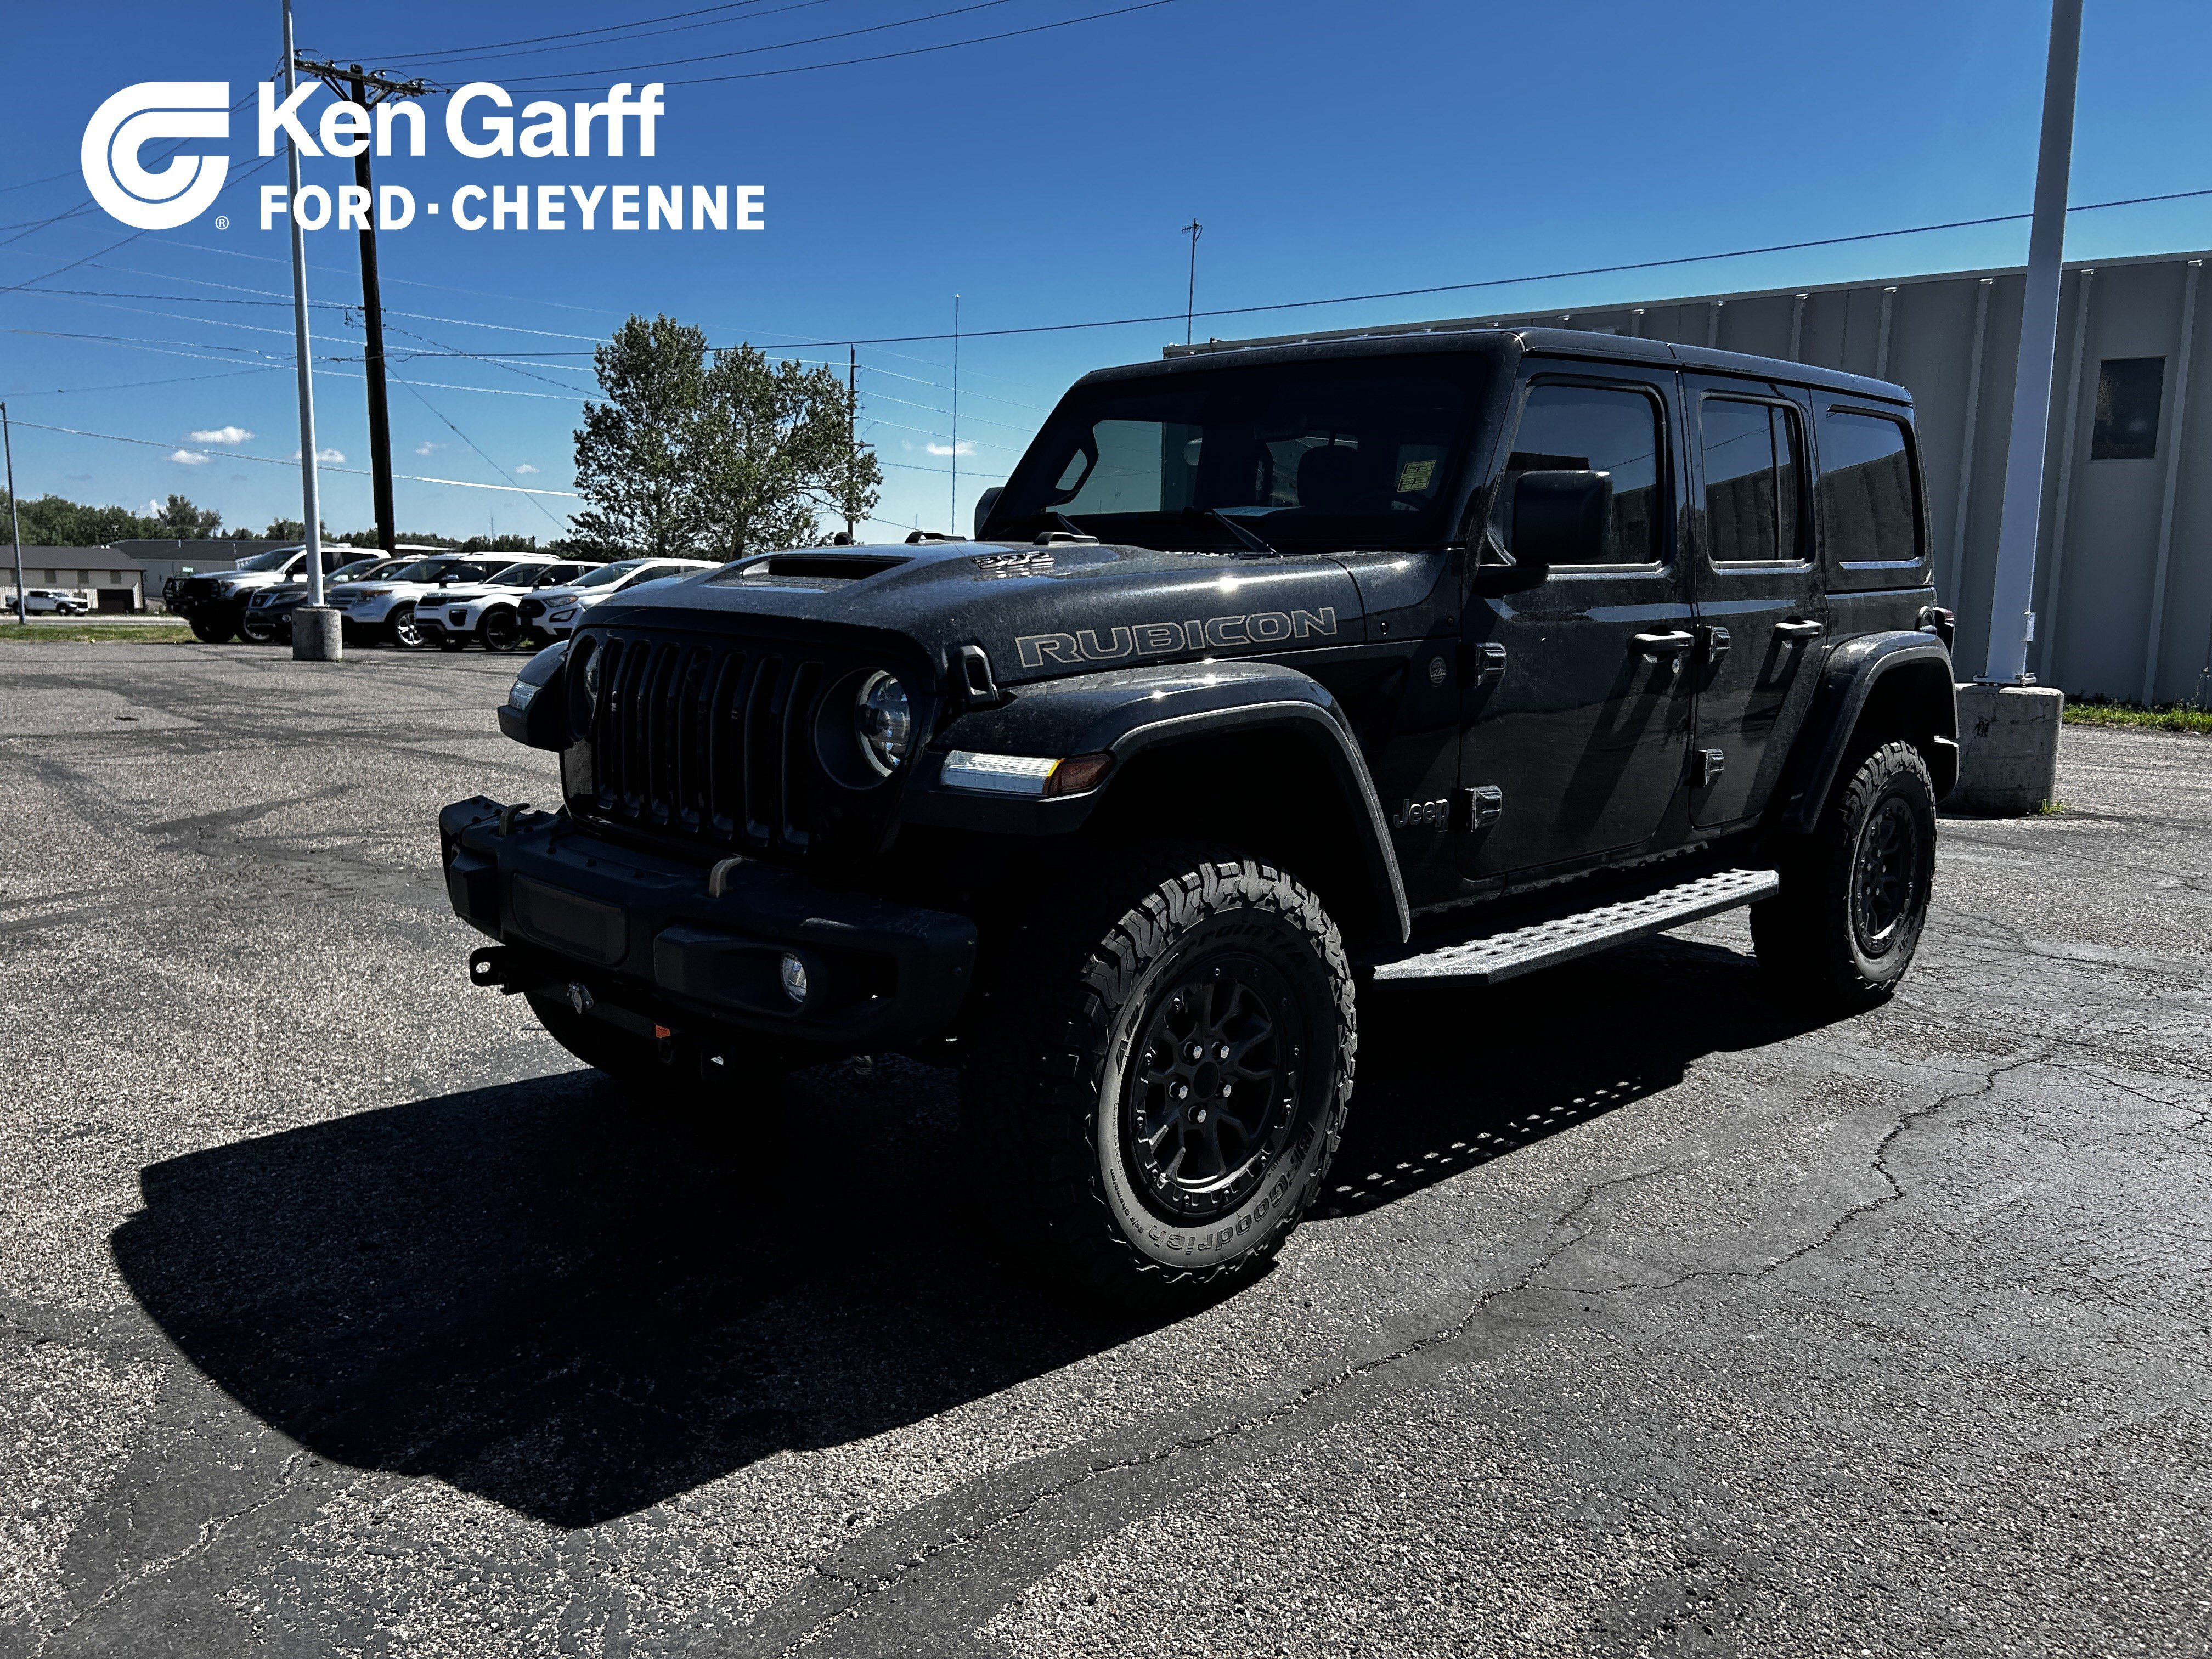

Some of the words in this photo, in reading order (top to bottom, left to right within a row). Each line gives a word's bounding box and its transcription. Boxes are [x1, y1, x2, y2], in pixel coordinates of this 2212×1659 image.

[972, 551, 1055, 569] 392
[1015, 606, 1338, 668] RUBICON
[1393, 798, 1449, 829] Jeep
[1148, 1120, 1317, 1256] BFGoodrich
